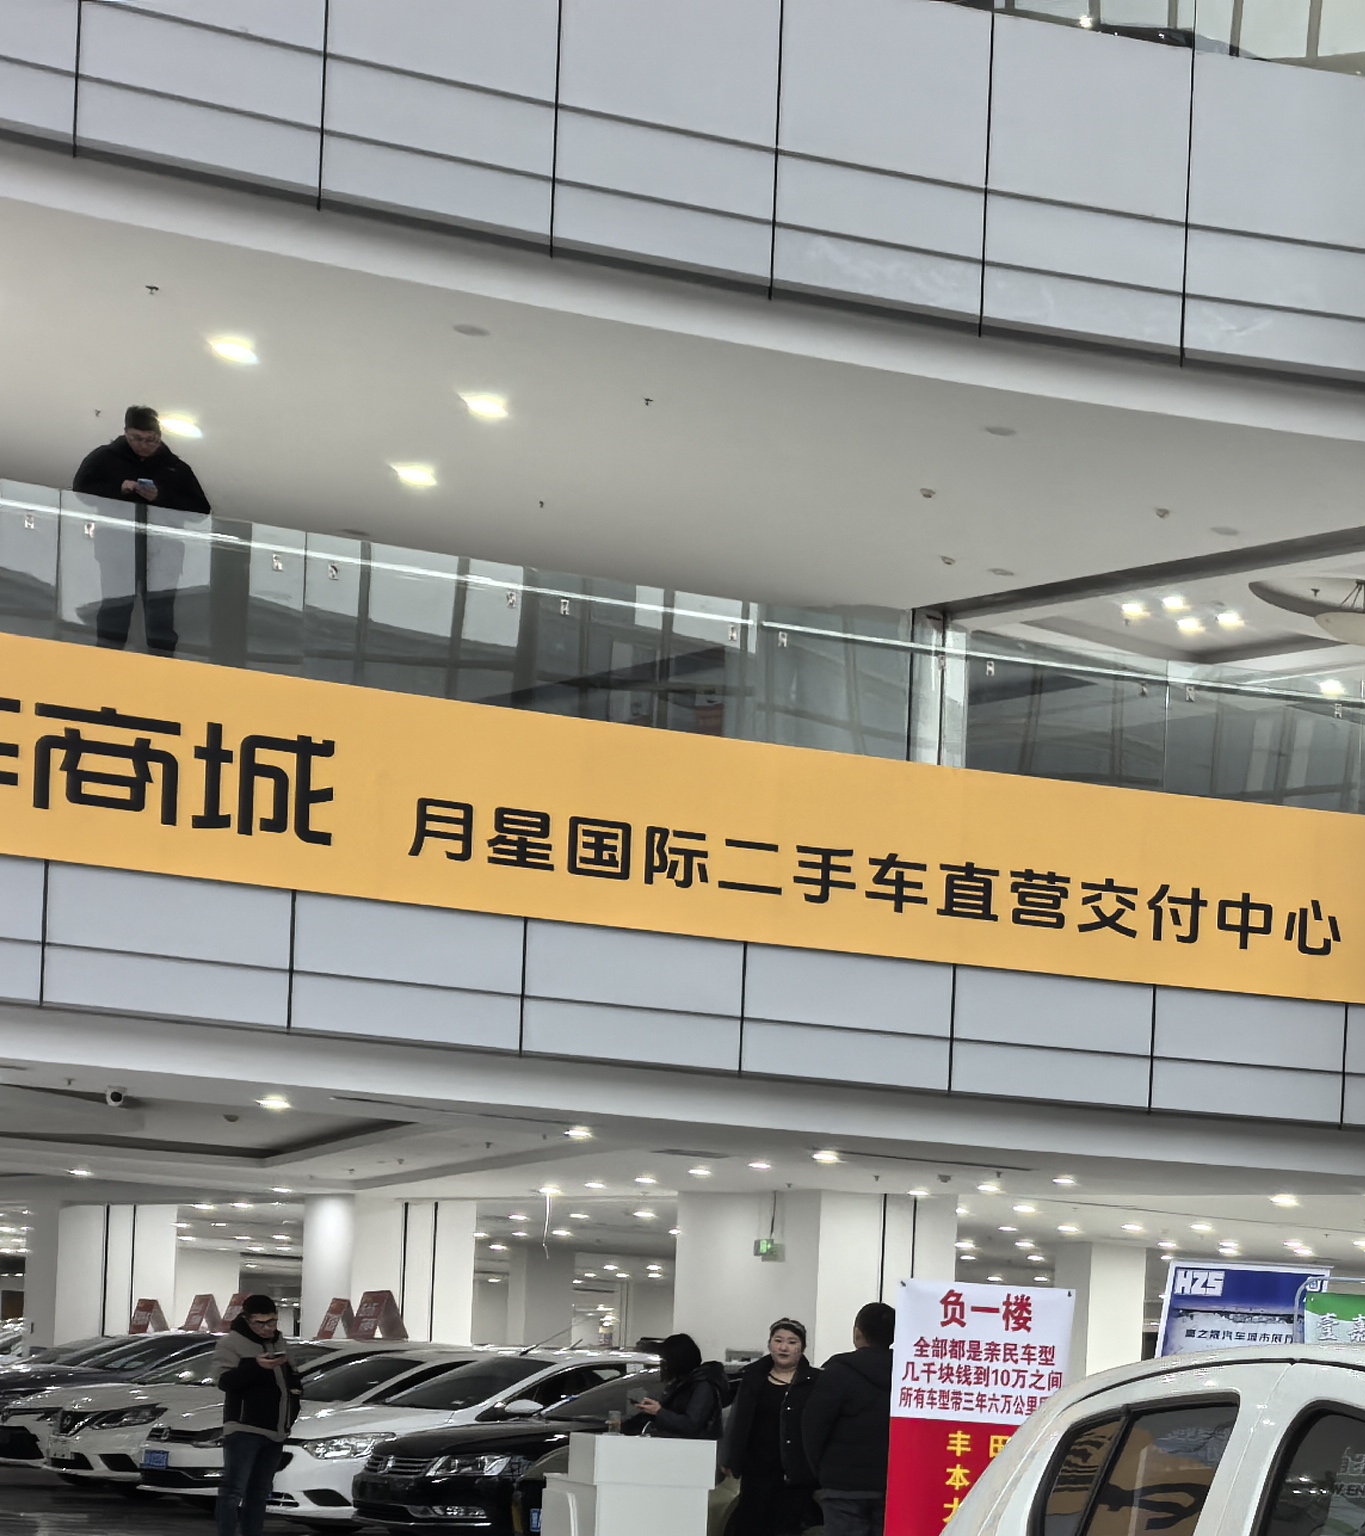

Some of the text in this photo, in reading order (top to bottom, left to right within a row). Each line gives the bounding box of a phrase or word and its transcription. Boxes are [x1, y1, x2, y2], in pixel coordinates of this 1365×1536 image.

[0, 700, 337, 847] 商城
[407, 796, 1343, 958] 月星国际二手车直营交付中心
[1174, 1269, 1225, 1297] HZS
[939, 1289, 1033, 1334] 负一楼
[913, 1336, 1056, 1367] 全部都是亲民车型
[901, 1361, 1063, 1391] 几千块钱到10万之间
